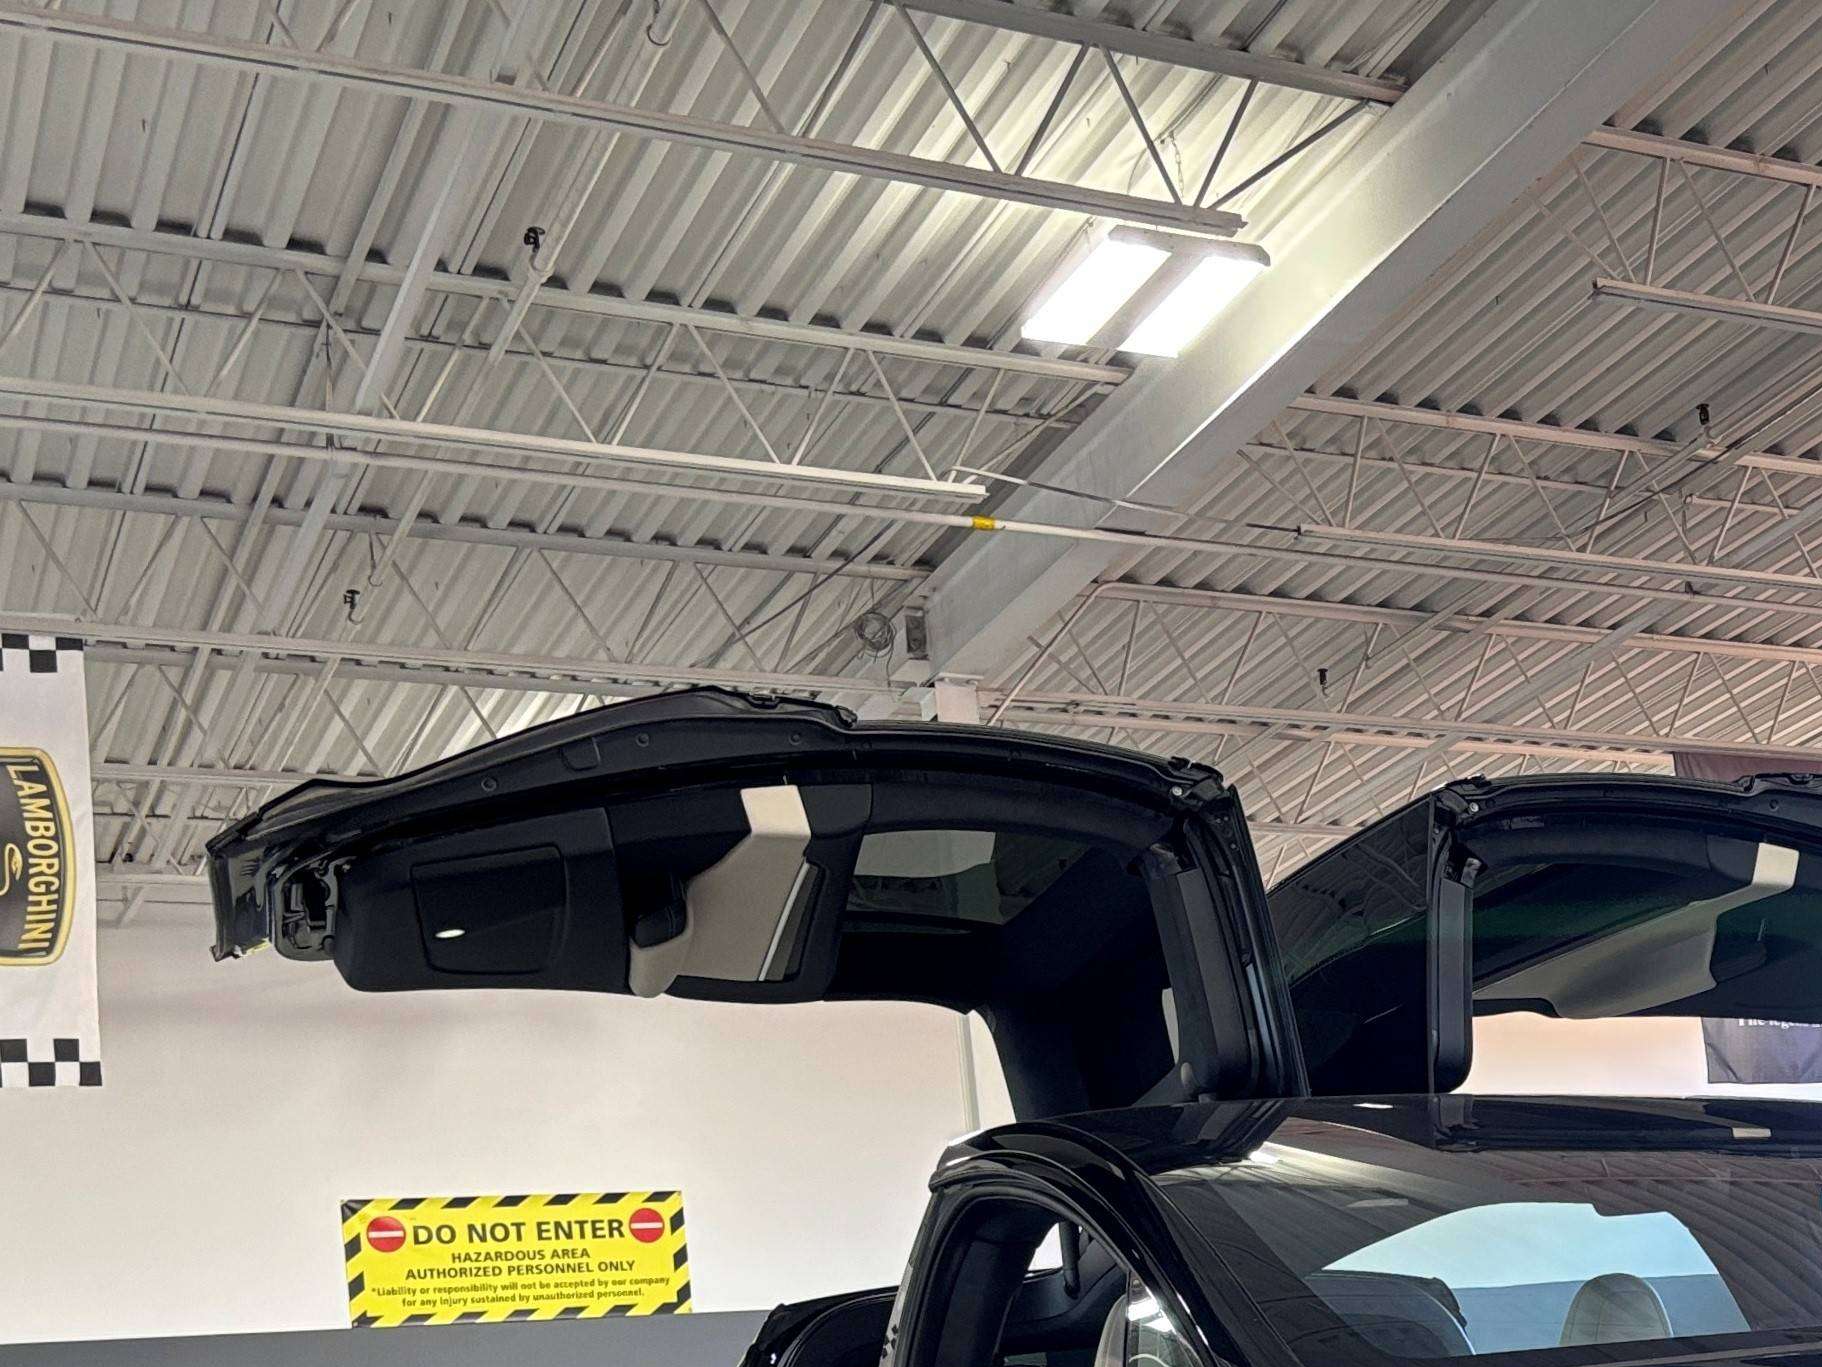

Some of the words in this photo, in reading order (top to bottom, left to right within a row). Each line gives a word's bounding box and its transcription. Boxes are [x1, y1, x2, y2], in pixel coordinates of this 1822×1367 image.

[6, 764, 61, 950] LAMBORGHINI
[412, 1224, 457, 1246] DO
[467, 1221, 526, 1244] NOT
[536, 1218, 626, 1241] ENTER
[451, 1249, 546, 1263] HAZARDOUS
[550, 1247, 591, 1260] AREA
[405, 1264, 503, 1280] AUTHORIZED
[507, 1262, 595, 1276] PERSONNEL
[597, 1260, 636, 1272] ONLY
[420, 1287, 430, 1295] or
[433, 1282, 498, 1295] responsibility
[501, 1282, 519, 1291] will
[520, 1281, 536, 1290] not
[539, 1280, 551, 1289] be
[553, 1278, 596, 1289] accepted
[597, 1278, 609, 1288] by
[629, 1277, 670, 1287] company
[402, 1297, 416, 1308] for
[420, 1298, 438, 1308] any
[440, 1295, 468, 1307] injury
[470, 1293, 517, 1304] sustained
[518, 1293, 531, 1303] by
[532, 1290, 595, 1301] unauthorized
